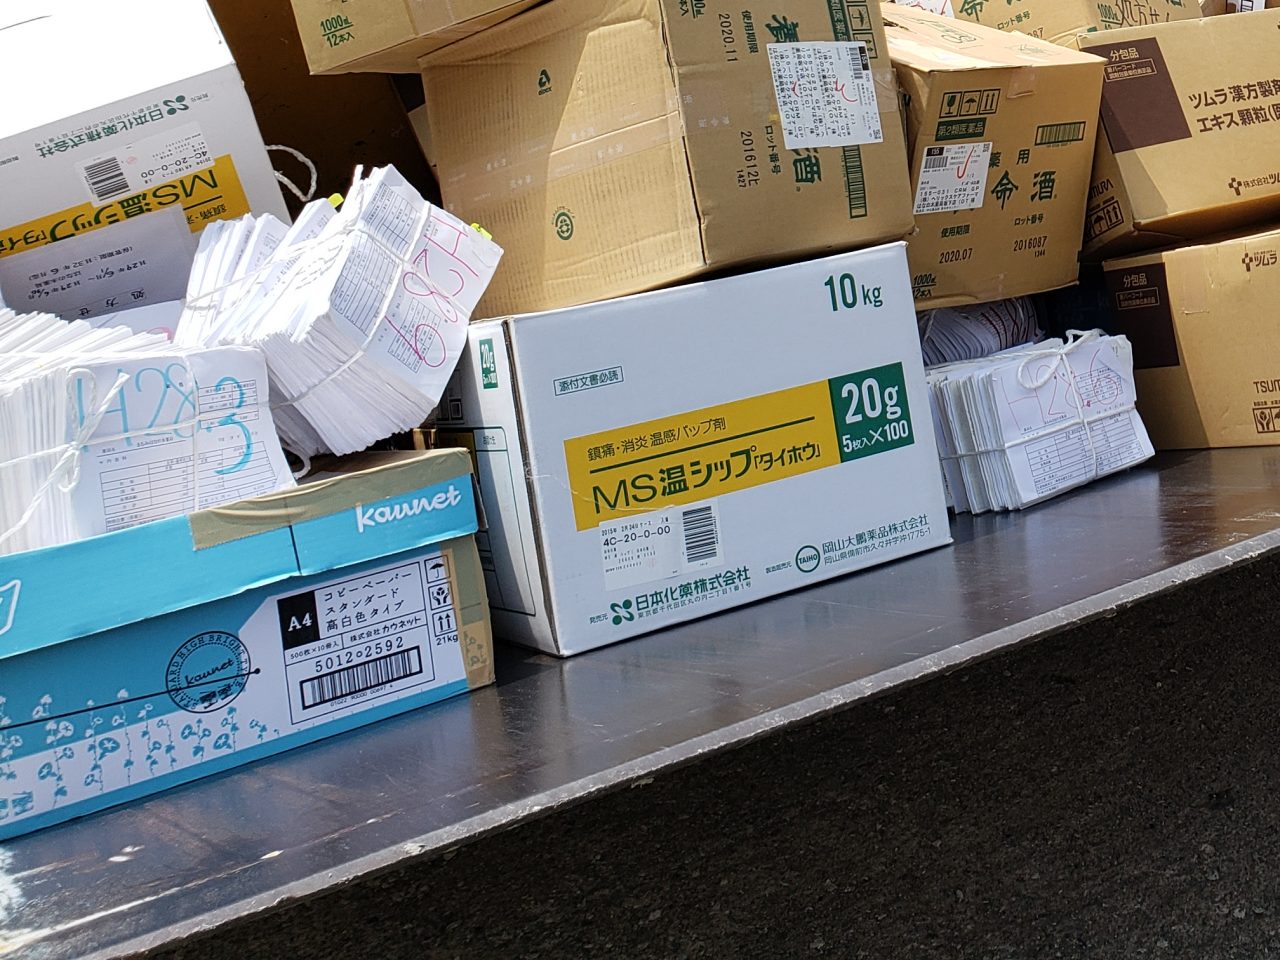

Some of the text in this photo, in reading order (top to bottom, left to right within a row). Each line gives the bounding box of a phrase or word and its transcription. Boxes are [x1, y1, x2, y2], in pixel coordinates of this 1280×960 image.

[997, 10, 1031, 30] ロット番号
[718, 13, 738, 63] 2020.11
[741, 9, 759, 54] 使用期限
[1110, 47, 1139, 61] 分包品
[38, 108, 164, 158] 日本化薬株式会社
[936, 121, 985, 137] 第2類医薬品
[764, 125, 782, 175] ロット番号
[1014, 213, 1044, 226] ロット番号
[941, 224, 971, 238] 使用期限
[1013, 235, 1048, 252] 2016087
[939, 247, 973, 264] 2020.07
[1254, 253, 1278, 267] ツムラ
[1123, 273, 1148, 288] 分包品
[78, 288, 146, 317] 処方せ
[558, 369, 619, 392] 添付文書必読
[841, 377, 902, 425] 20g
[355, 484, 463, 534] kaunet
[603, 525, 671, 547] 4C-20-0-00
[822, 513, 929, 555] 岡山大鵬薬品株式会社
[798, 554, 818, 565] TAIHO
[324, 572, 412, 602] コピーペーパー
[635, 565, 751, 611] 日本化薬株式会社
[325, 587, 400, 615] スタンダード
[287, 611, 313, 632] A4
[326, 599, 404, 632] 高白色タイプ
[589, 613, 609, 625] 発売元
[436, 634, 458, 646] 21kg
